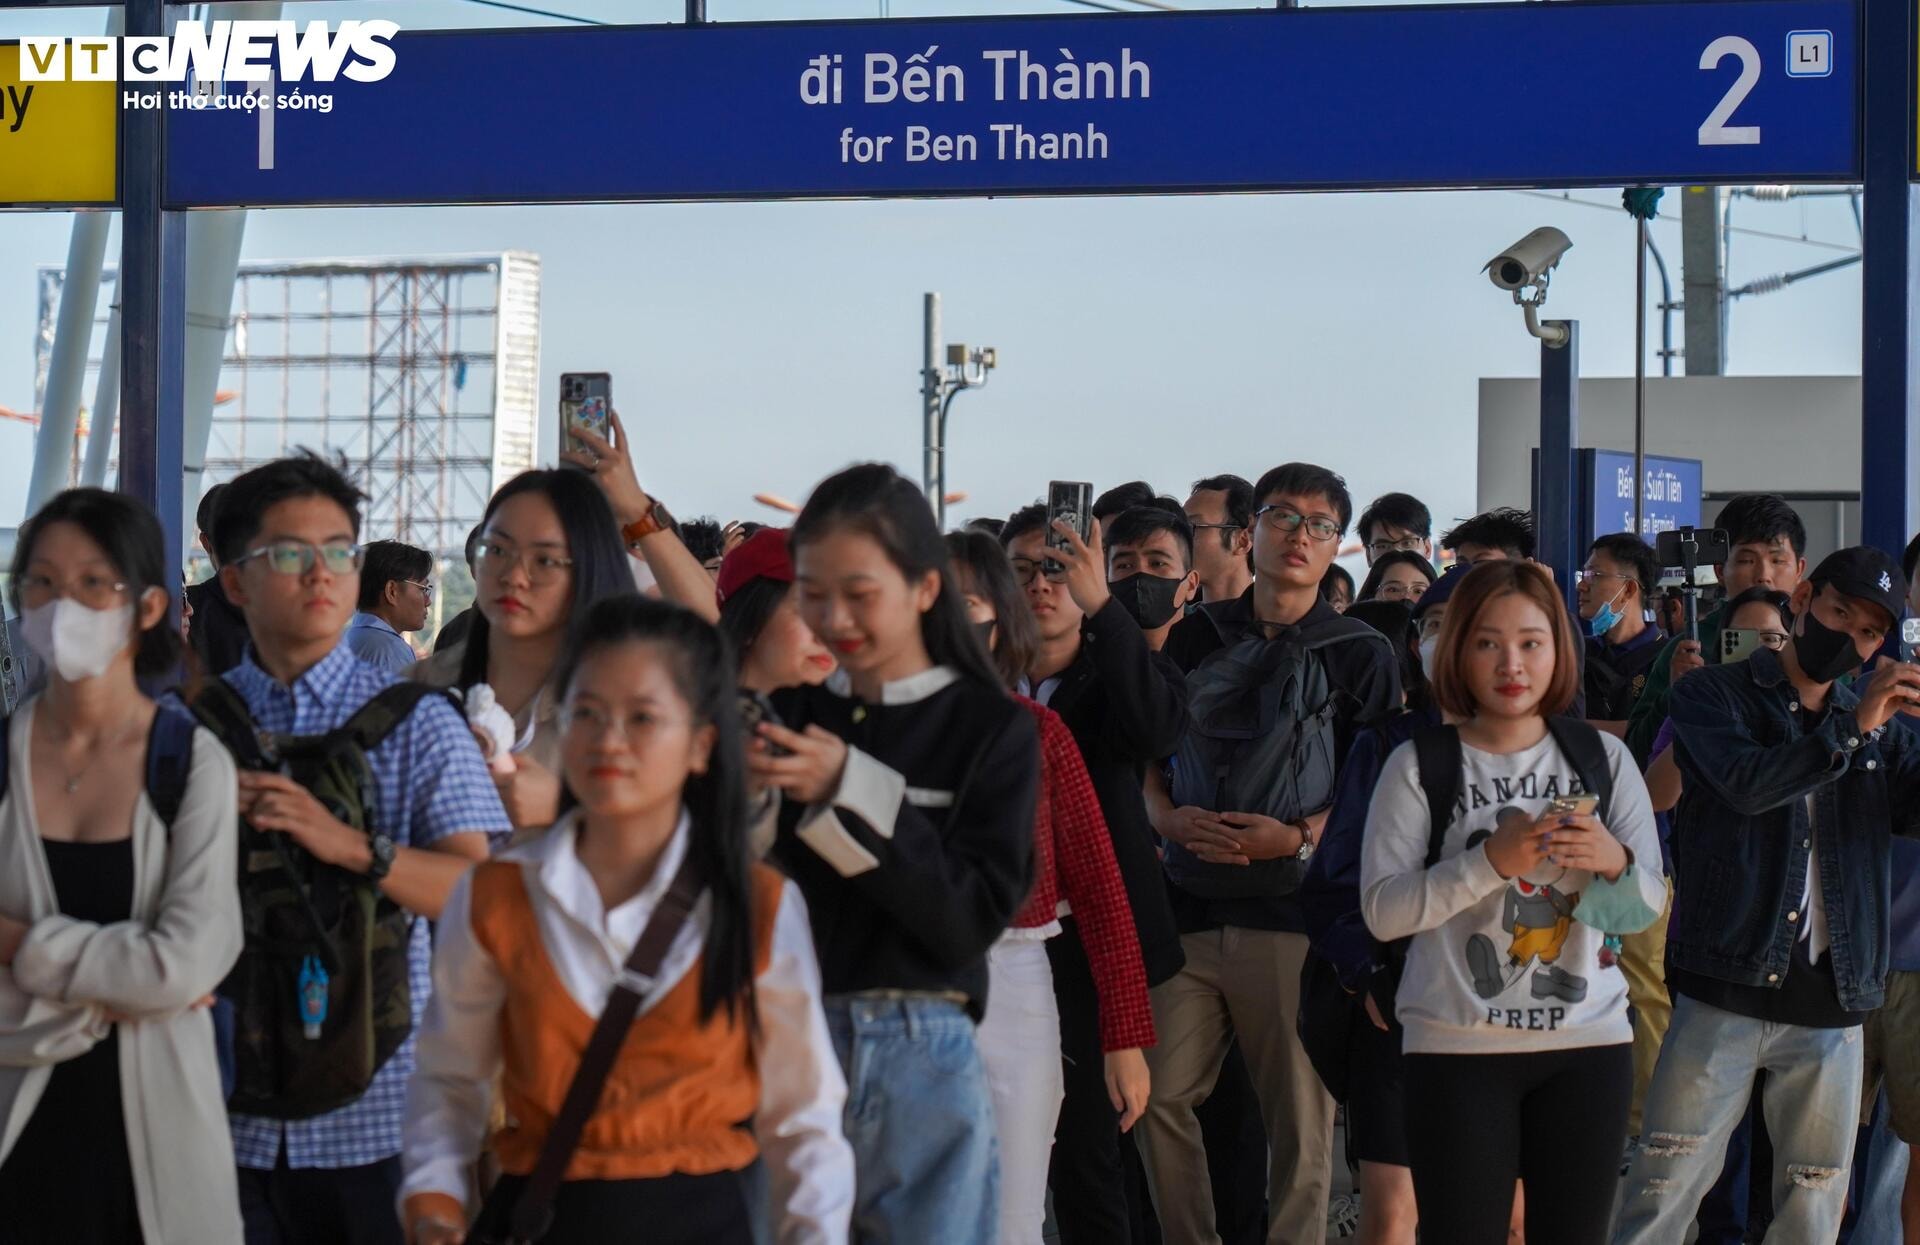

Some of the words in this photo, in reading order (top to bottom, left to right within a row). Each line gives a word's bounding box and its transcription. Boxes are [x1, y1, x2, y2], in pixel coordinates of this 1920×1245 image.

[1800, 44, 1819, 63] L1
[800, 53, 843, 105] đi
[864, 45, 964, 104] Bến
[982, 48, 1150, 101] Thành
[1698, 35, 1762, 146] 2
[840, 127, 894, 163] for
[906, 125, 977, 162] Ben
[989, 122, 1108, 161] Thanh
[1485, 1005, 1565, 1031] PREP
